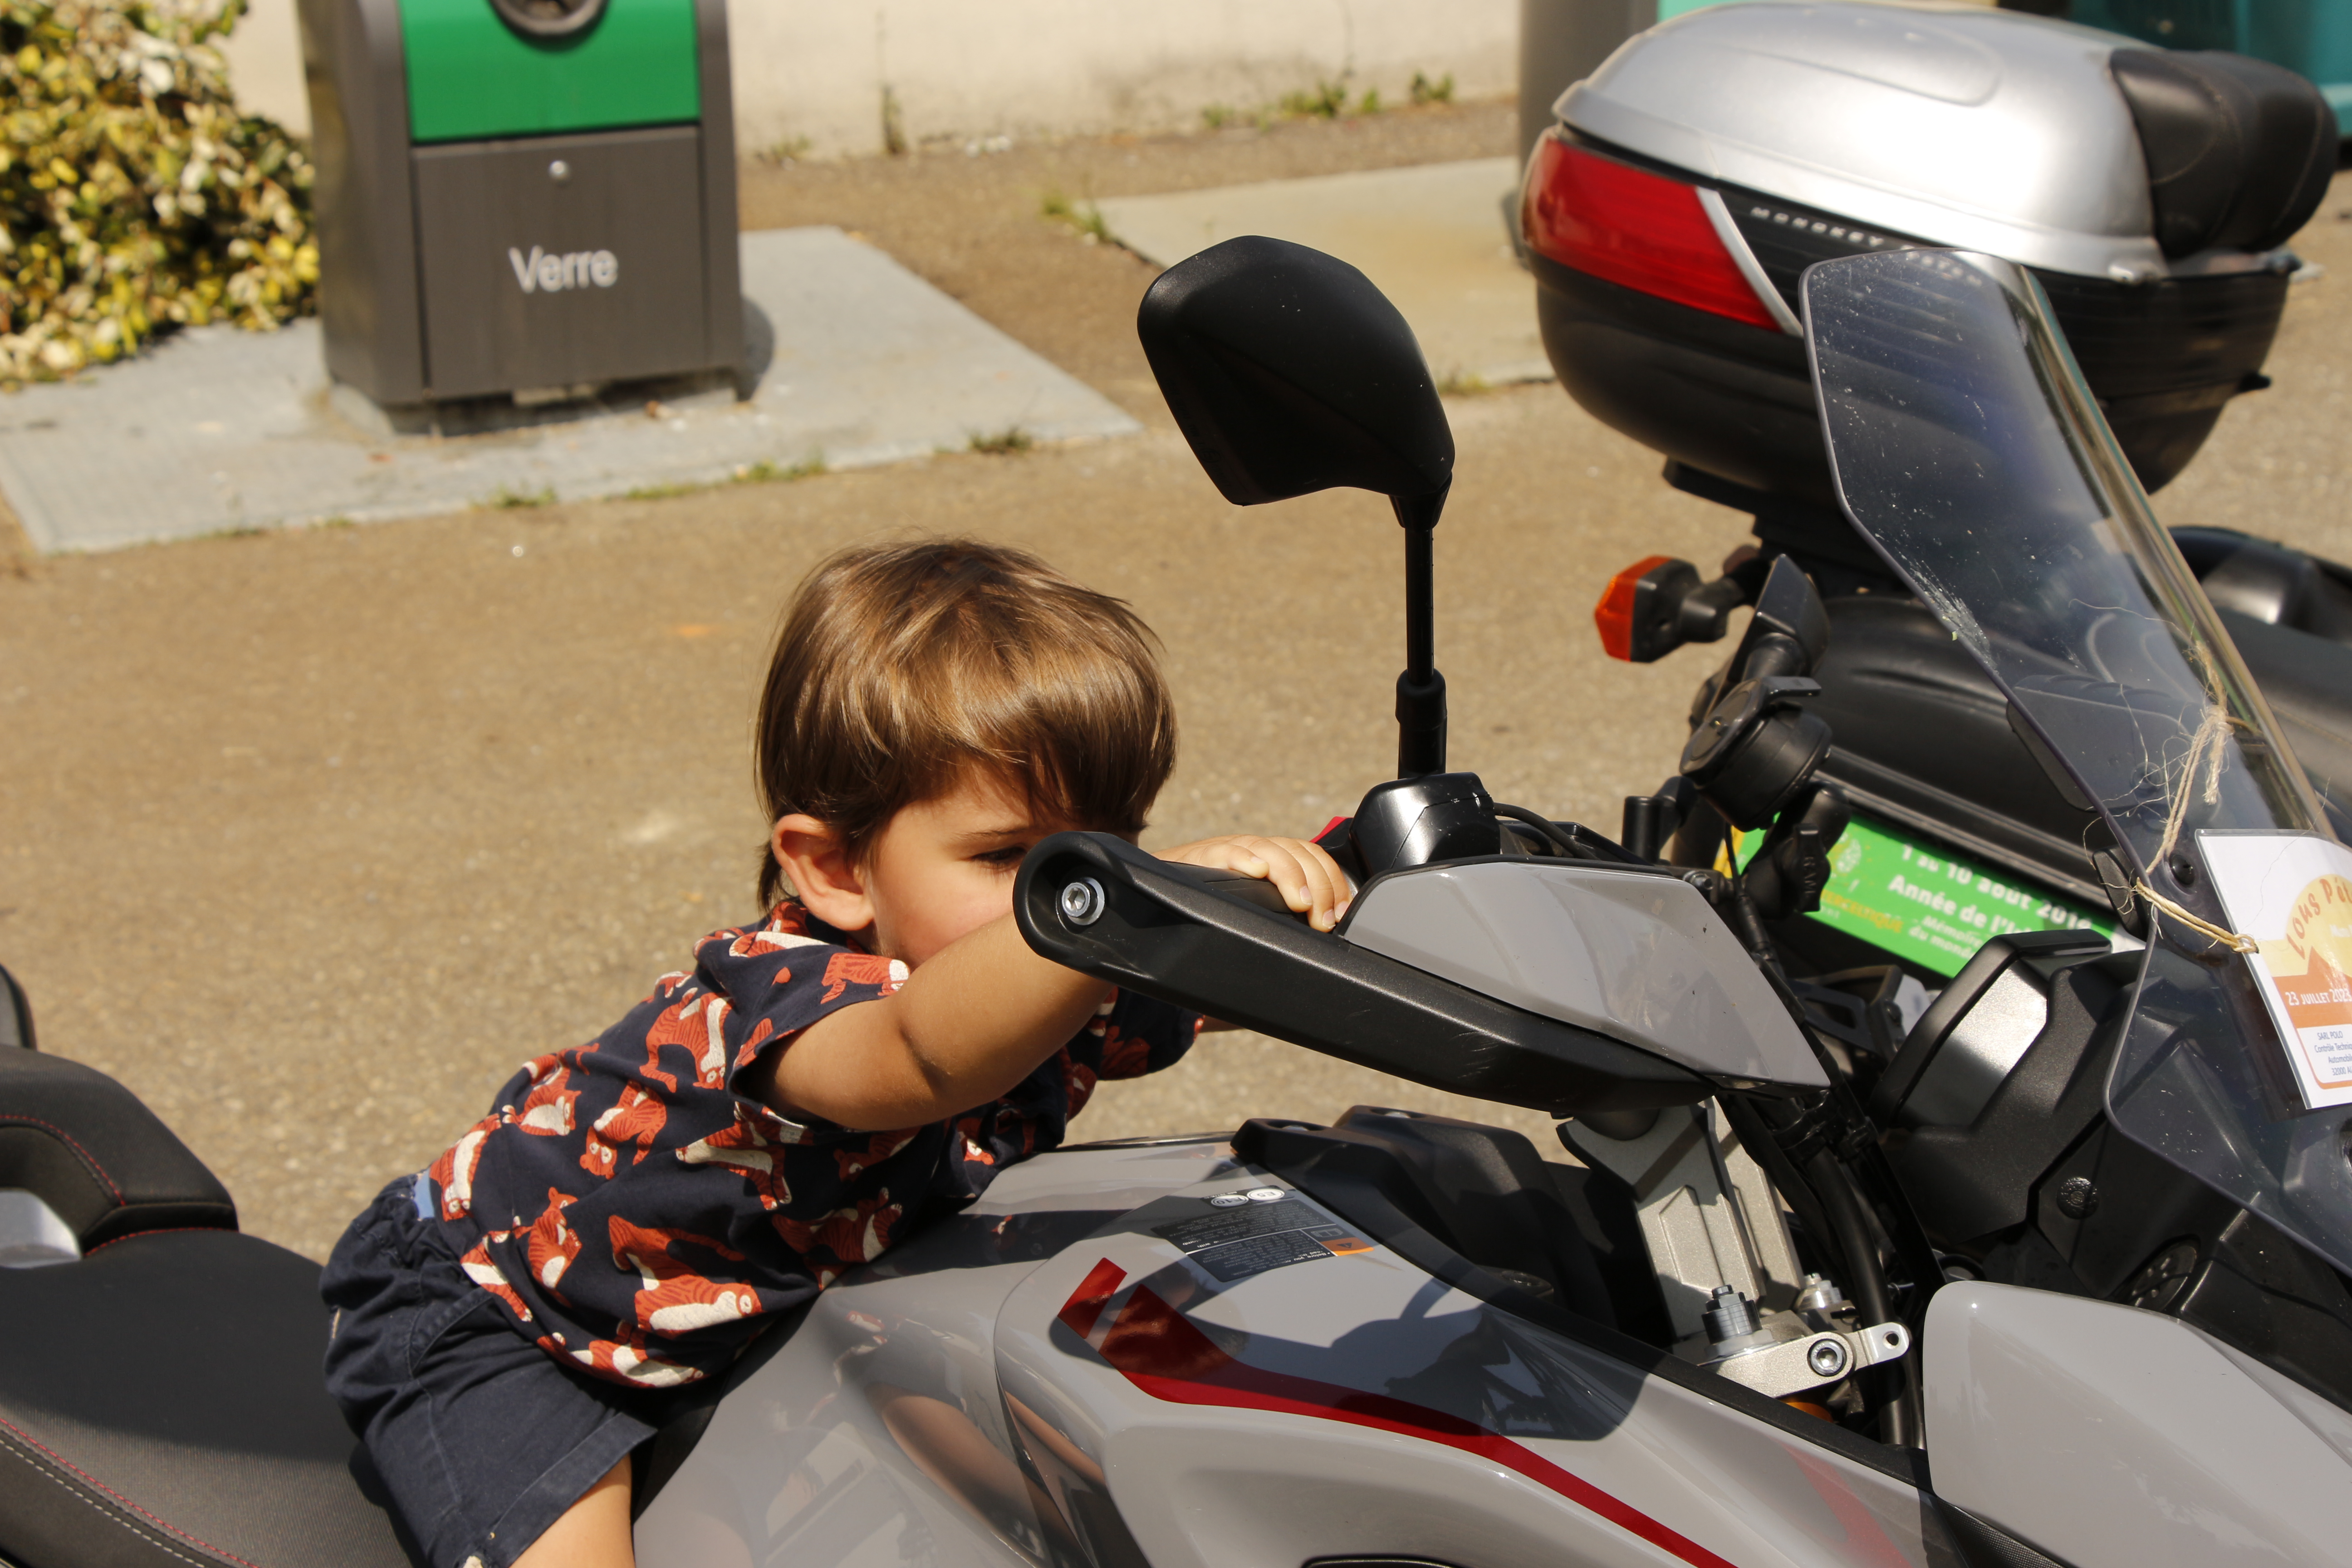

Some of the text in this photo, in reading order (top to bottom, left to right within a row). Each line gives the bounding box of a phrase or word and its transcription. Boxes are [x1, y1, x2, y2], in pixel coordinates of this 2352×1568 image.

[1751, 206, 1884, 247] MONOKEY
[508, 245, 618, 293] Verre
[1917, 855, 1939, 872] au
[1947, 862, 1973, 885] 10
[1977, 877, 2033, 910] août
[1888, 874, 1957, 916] Année
[1959, 905, 1987, 928] de
[1909, 926, 1929, 941] du
[2285, 988, 2352, 1006] 23 JUILLET 2023
[2330, 1031, 2343, 1039] POLO
[2314, 1044, 2335, 1053] Contrôle
[2332, 1067, 2347, 1076] 32000
[1216, 1196, 1243, 1205] E10
